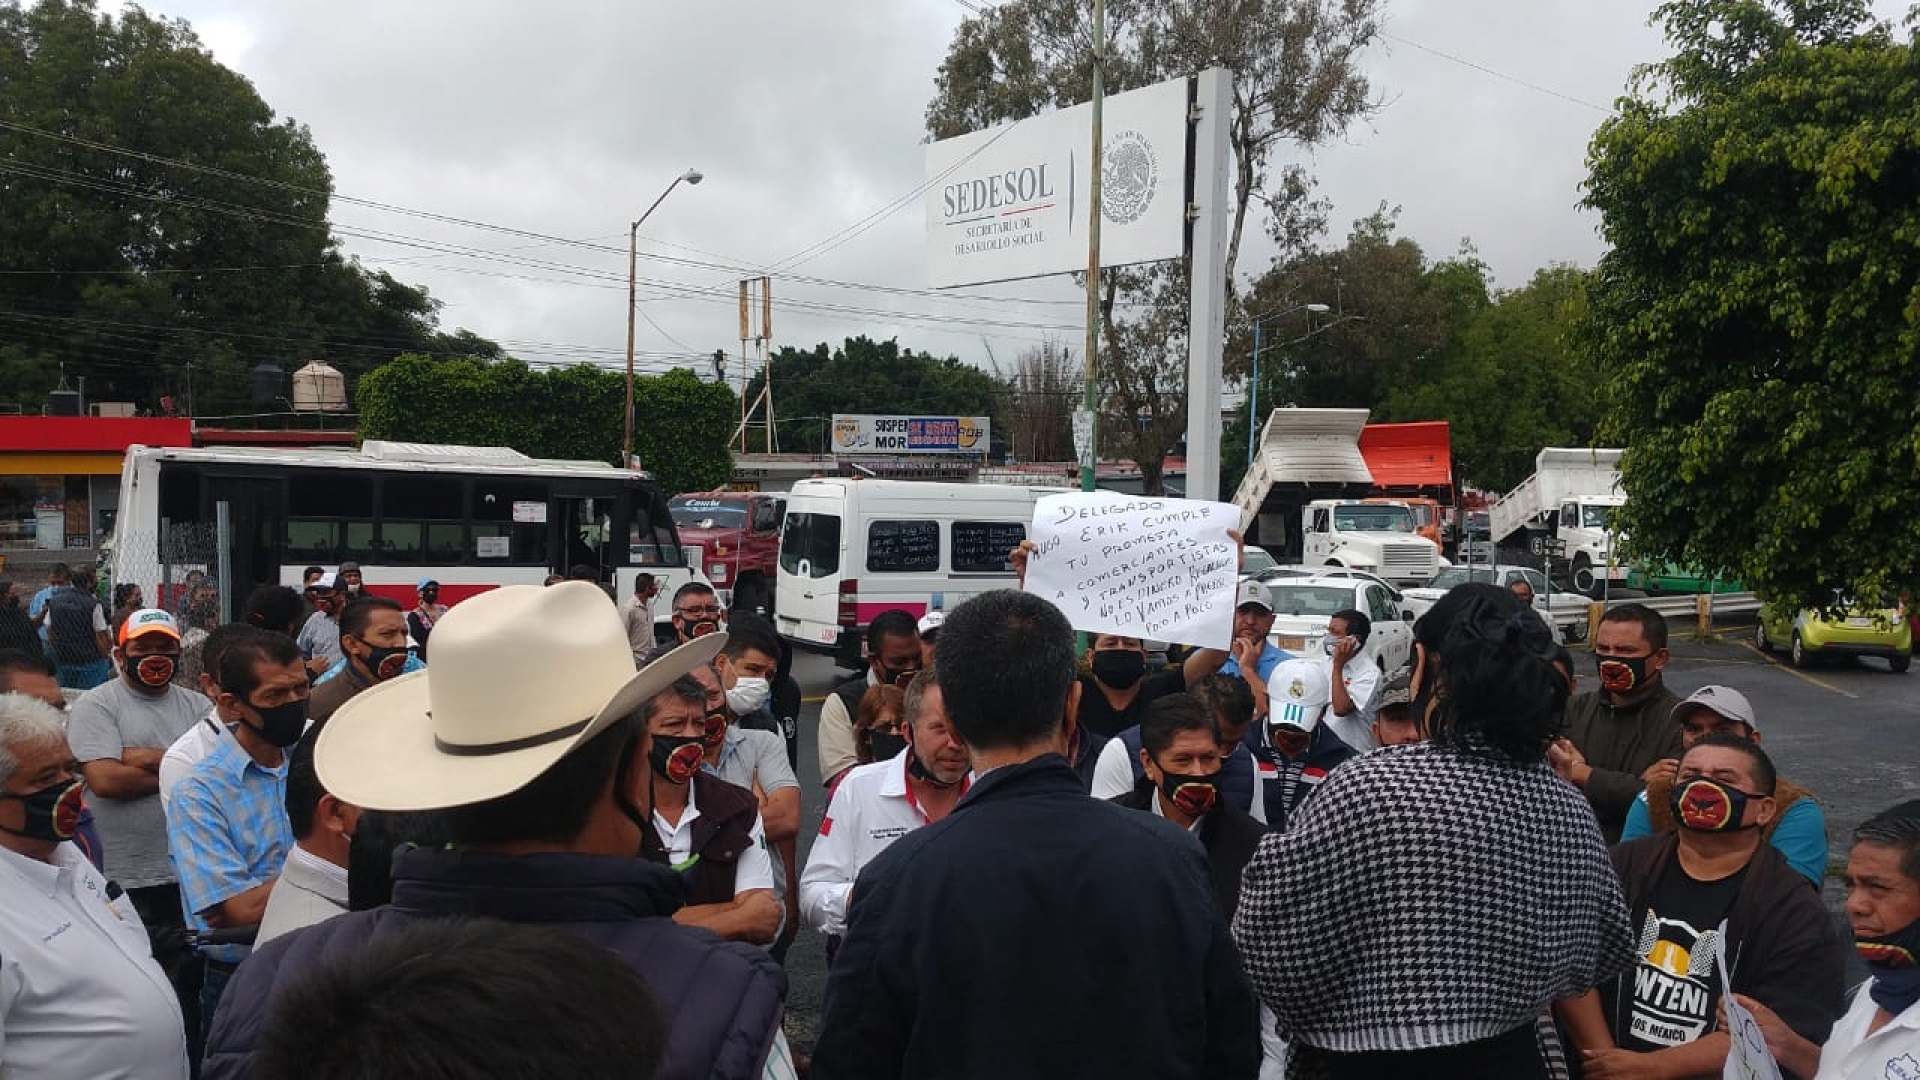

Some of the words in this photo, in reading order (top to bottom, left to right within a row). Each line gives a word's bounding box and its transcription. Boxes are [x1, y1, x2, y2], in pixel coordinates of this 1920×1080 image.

[944, 162, 1054, 218] SEDESOL
[1012, 231, 1045, 247] SOCIAL
[1020, 217, 1032, 229] DE
[1054, 502, 1164, 525] DELEGADO
[1080, 521, 1128, 542] ERIK
[1142, 506, 1210, 528] CUMPLE
[1065, 554, 1088, 570] TU
[1102, 529, 1178, 558] PROMESA
[1077, 538, 1198, 590] COMERCIANTES
[1099, 542, 1228, 600] TRANSPORTISTAS
[1138, 575, 1182, 600] DINERO
[1114, 611, 1132, 626] LO
[1136, 593, 1179, 623] VAMOS
